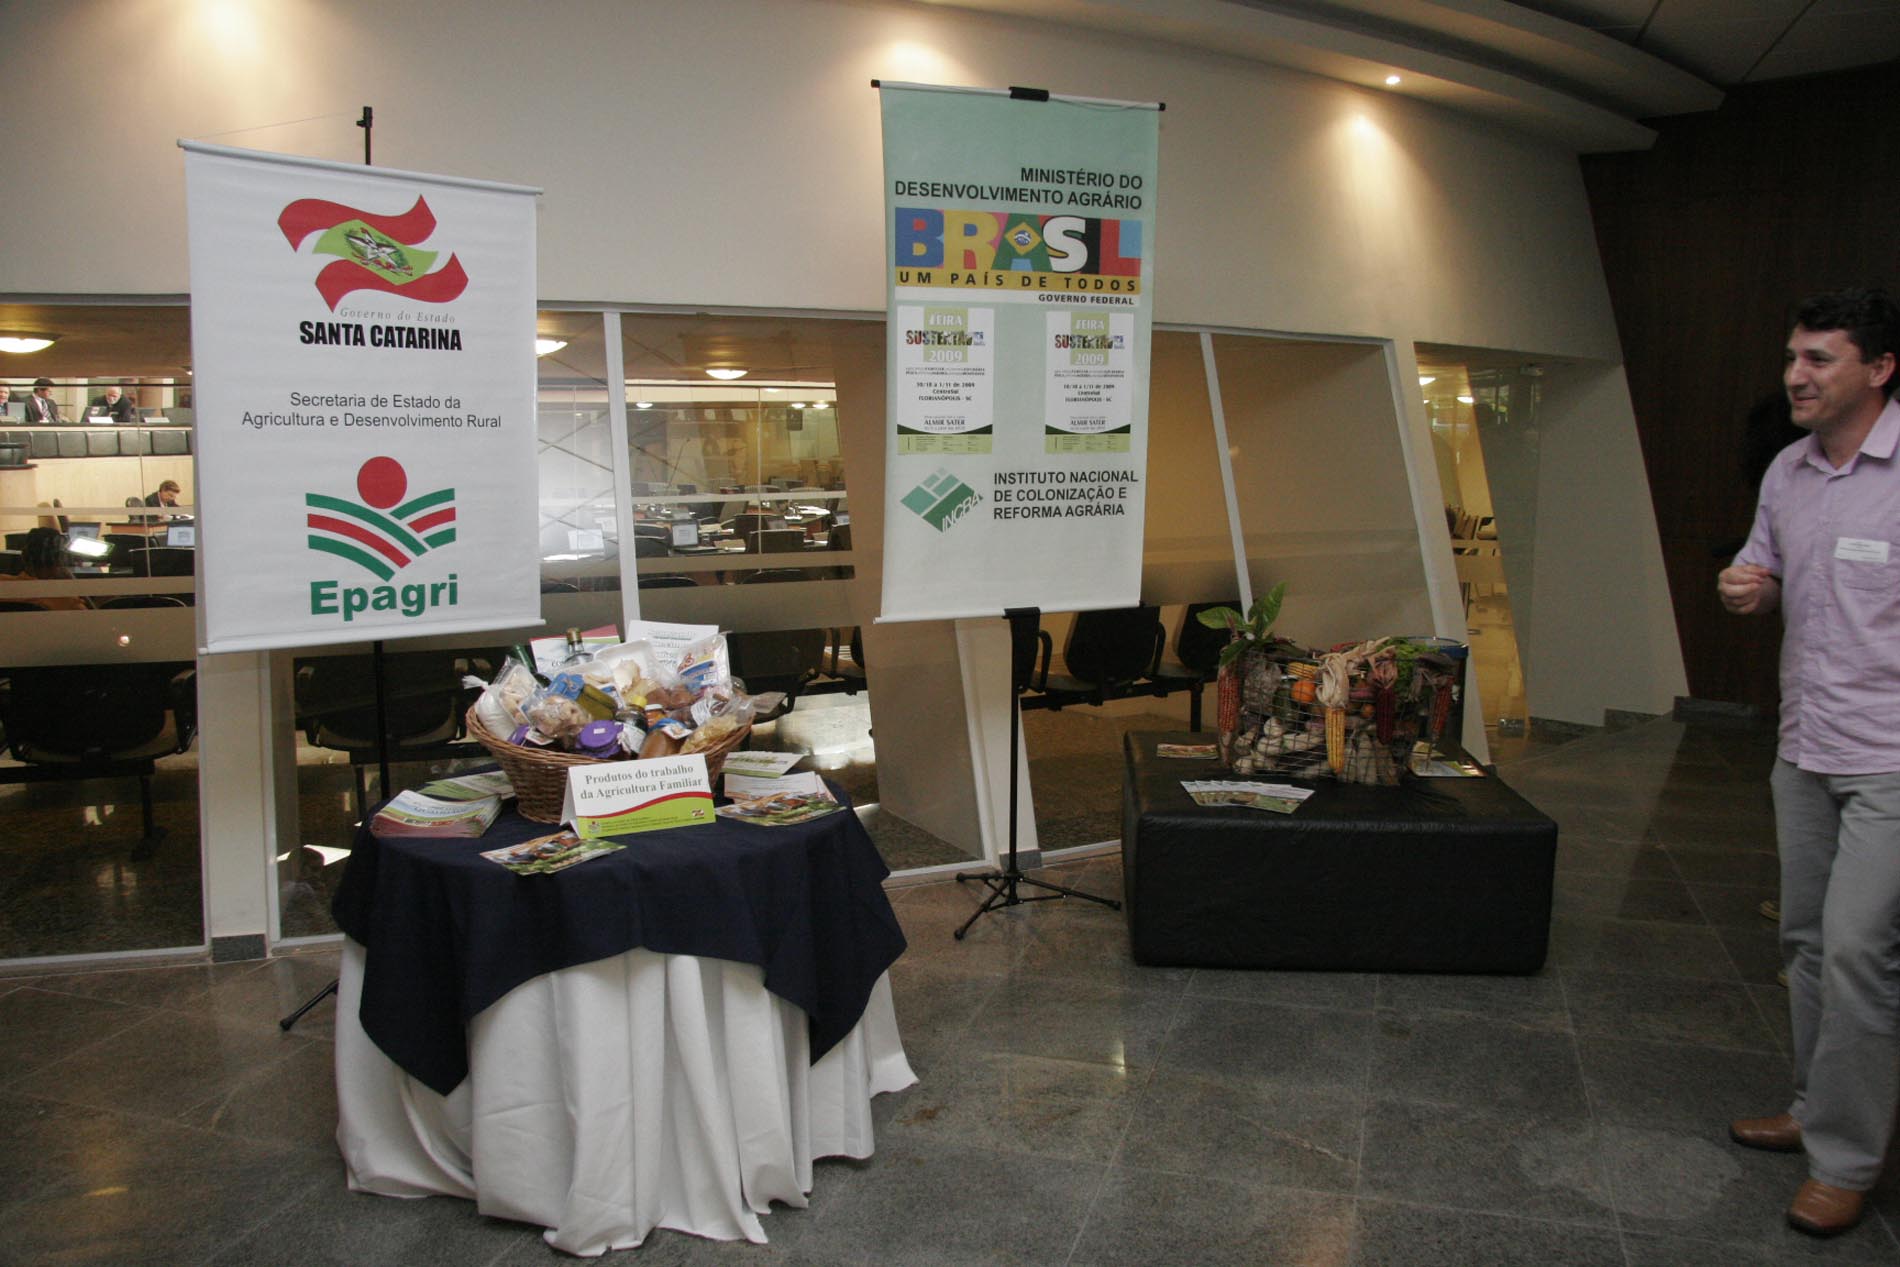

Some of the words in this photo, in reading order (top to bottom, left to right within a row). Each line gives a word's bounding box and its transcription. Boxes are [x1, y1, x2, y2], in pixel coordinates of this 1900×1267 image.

[1021, 167, 1115, 189] MINISTÉRIO
[1119, 174, 1143, 189] DO
[895, 181, 1063, 204] DESENVOLVIMENTO
[1068, 192, 1142, 210] AGRÁRIO
[895, 207, 1142, 277] BRASIL
[900, 271, 932, 284] UM
[950, 271, 1004, 286] PAÍS
[1021, 275, 1047, 288] DE
[1065, 277, 1136, 291] TODOS
[1038, 294, 1087, 304] GOVERNO
[1090, 295, 1134, 306] FEDERAL
[340, 307, 392, 321] Governo
[398, 310, 411, 321] do
[416, 312, 456, 324] Estado
[299, 320, 366, 347] SANTA
[370, 324, 463, 351] CATARINA
[930, 350, 963, 362] 2009
[1076, 354, 1104, 365] 2009
[290, 392, 367, 409] Secretaria
[370, 394, 388, 409] de
[393, 394, 440, 409] Estado
[444, 395, 461, 409] da
[242, 411, 325, 431] Agricultura
[330, 415, 339, 427] e
[344, 413, 463, 428] Desenvolvimento
[466, 414, 501, 428] Rural
[994, 473, 1066, 484] INSTITUTO
[1070, 471, 1138, 483] NACIONAL
[994, 491, 1012, 502] DE
[1016, 486, 1115, 503] COLONIZAÇÃO
[1119, 488, 1127, 498] E
[942, 491, 983, 532] INCRA
[994, 509, 1062, 520] REFORMA
[1065, 502, 1125, 516] AGRÁRIA
[310, 573, 458, 622] Epagri
[586, 773, 633, 785] Produtos
[635, 770, 648, 779] do
[650, 764, 694, 777] trabalho
[580, 789, 594, 800] da
[596, 784, 657, 799] Agricultura
[659, 777, 703, 790] Familiar
